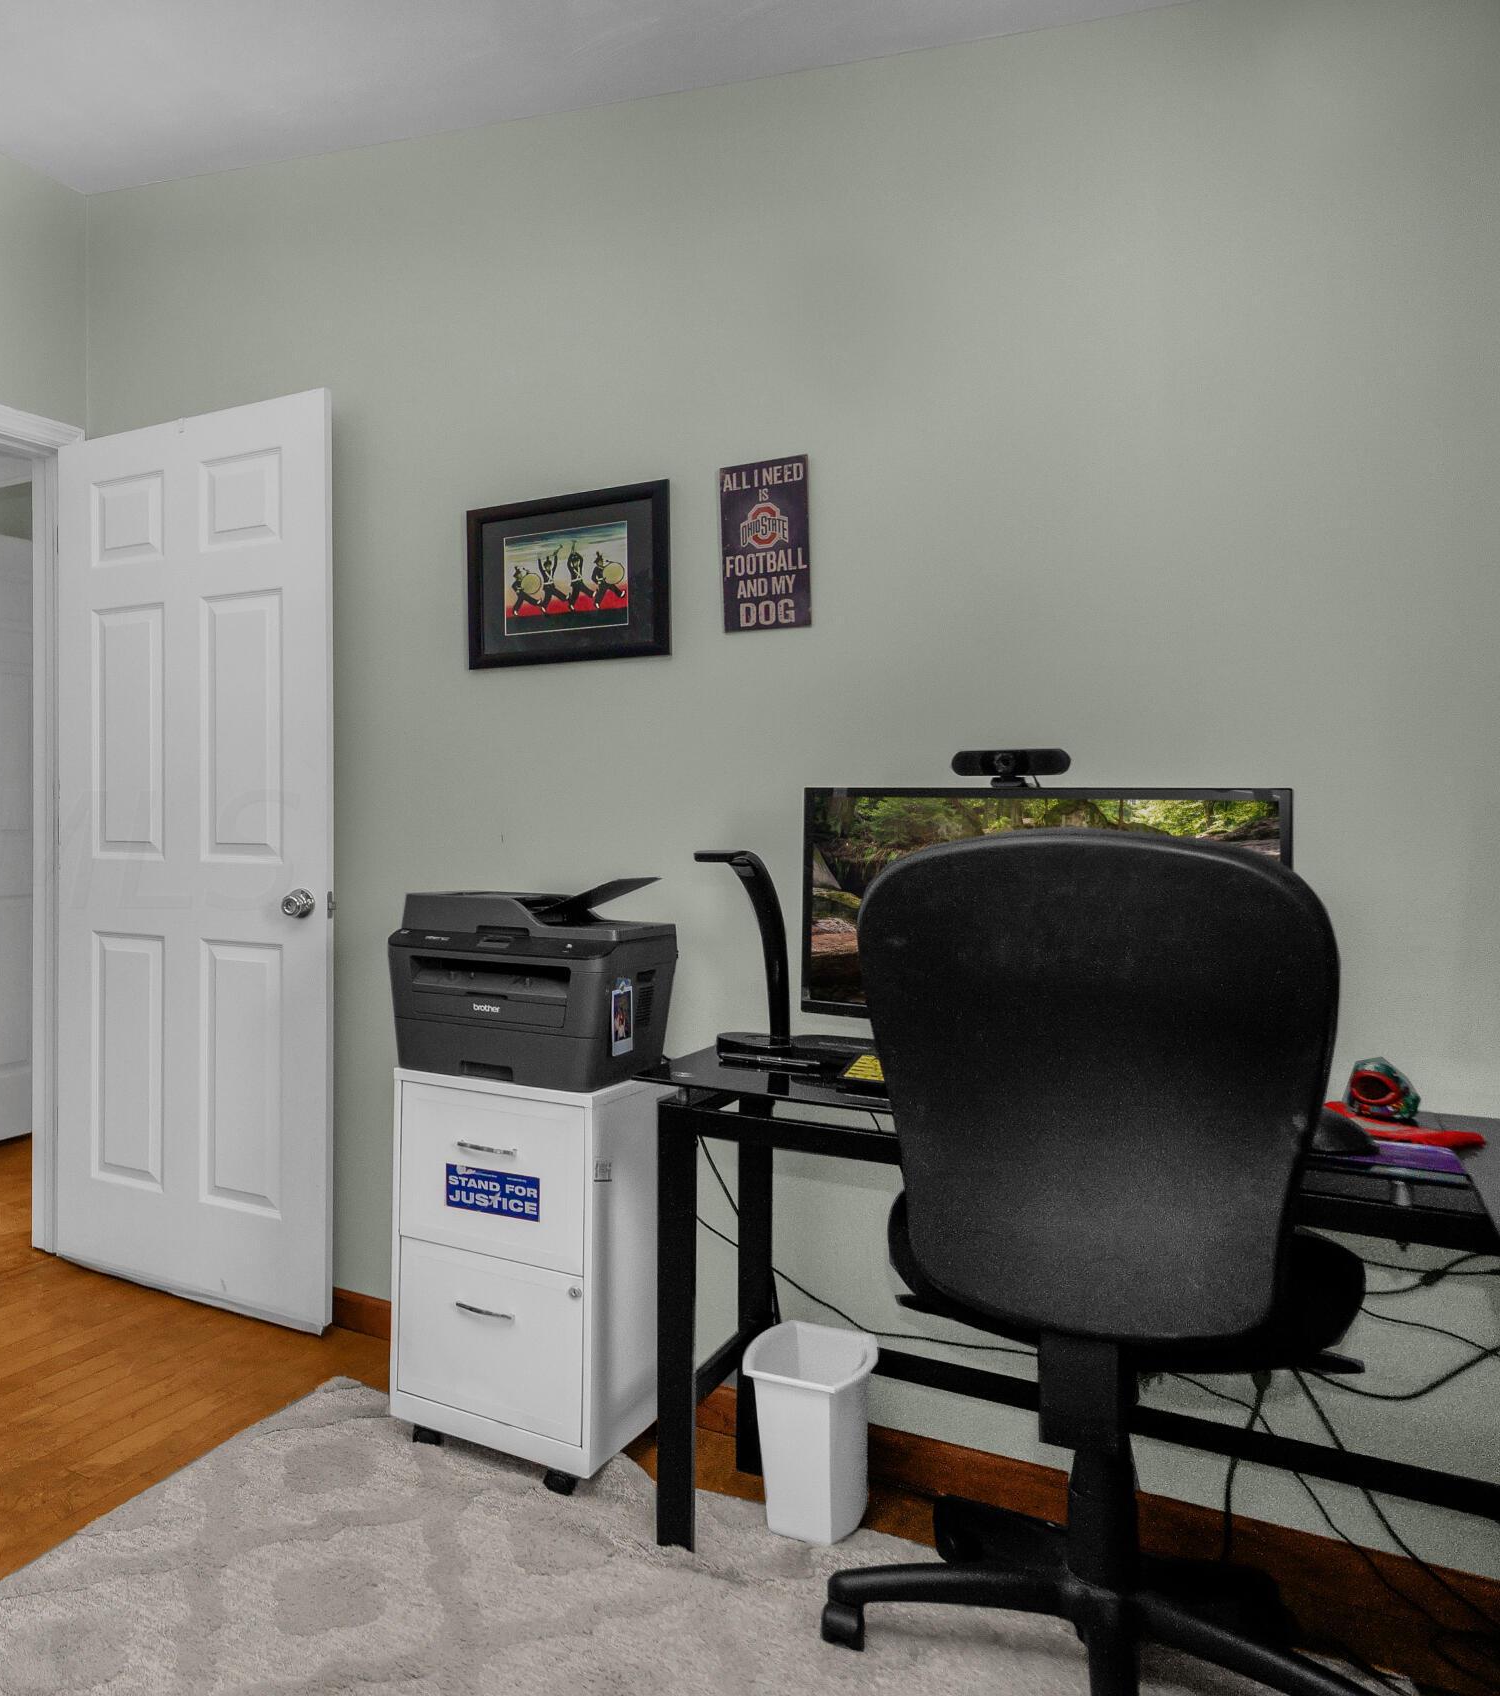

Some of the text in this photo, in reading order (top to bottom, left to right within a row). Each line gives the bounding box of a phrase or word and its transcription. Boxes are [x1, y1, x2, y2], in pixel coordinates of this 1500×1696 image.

[723, 462, 804, 492] ALL I NEED
[758, 488, 769, 502] IS
[725, 547, 807, 578] FOOTBALL
[737, 575, 796, 599] AND MY
[740, 599, 795, 627] DOG
[472, 1002, 501, 1014] brother
[448, 1175, 500, 1192] STAND
[505, 1184, 538, 1199] FOR
[449, 1190, 538, 1215] JUSTICE
